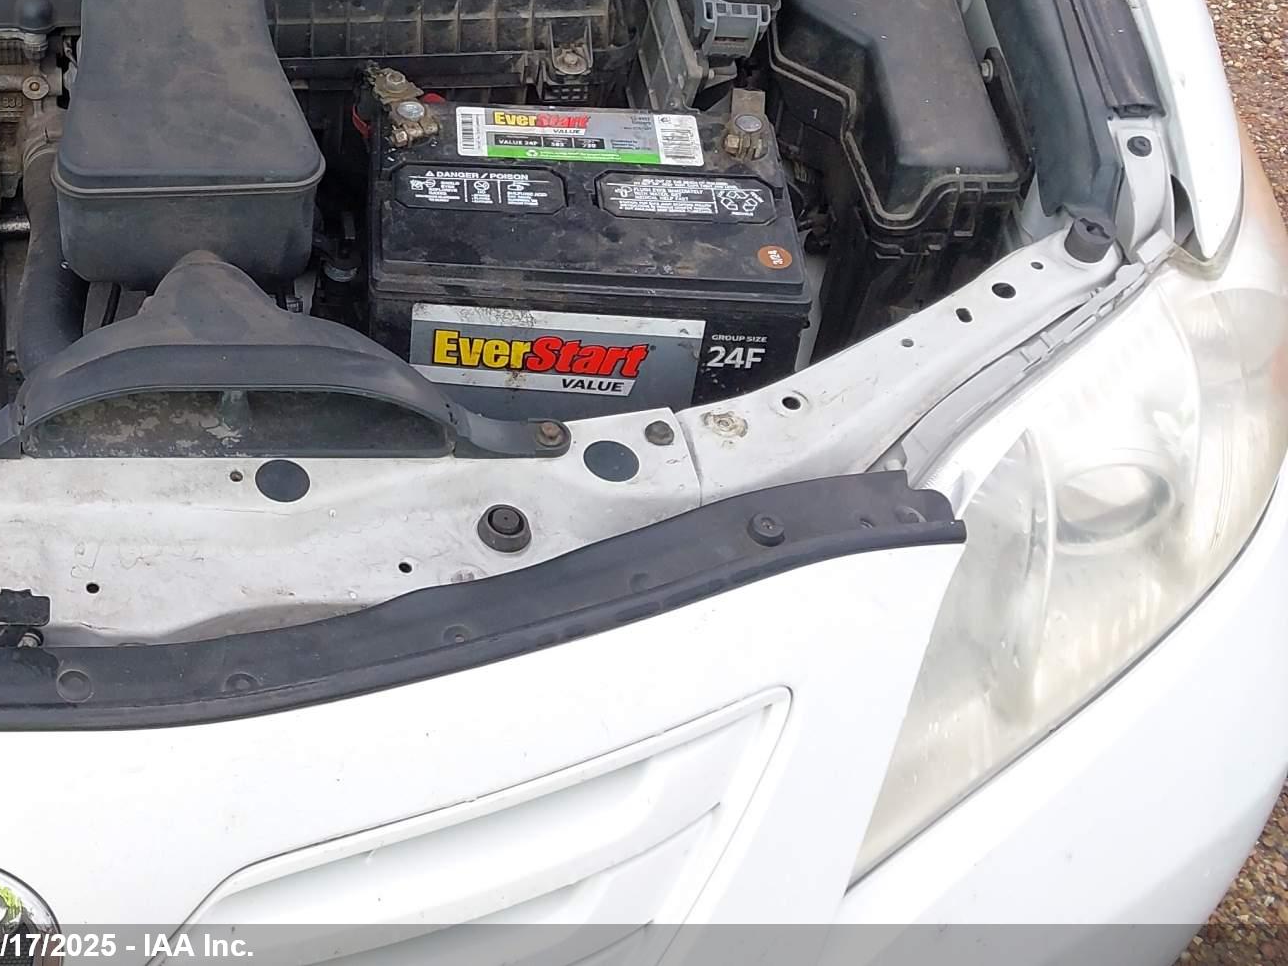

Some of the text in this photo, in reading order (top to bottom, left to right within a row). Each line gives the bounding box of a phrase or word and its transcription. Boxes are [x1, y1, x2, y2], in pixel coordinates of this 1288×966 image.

[493, 111, 591, 129] EverStart
[436, 171, 479, 179] DANGER
[711, 334, 745, 342] GROUP
[433, 329, 649, 377] EverStart
[707, 345, 766, 370] 24F
[562, 378, 623, 392] VALUE
